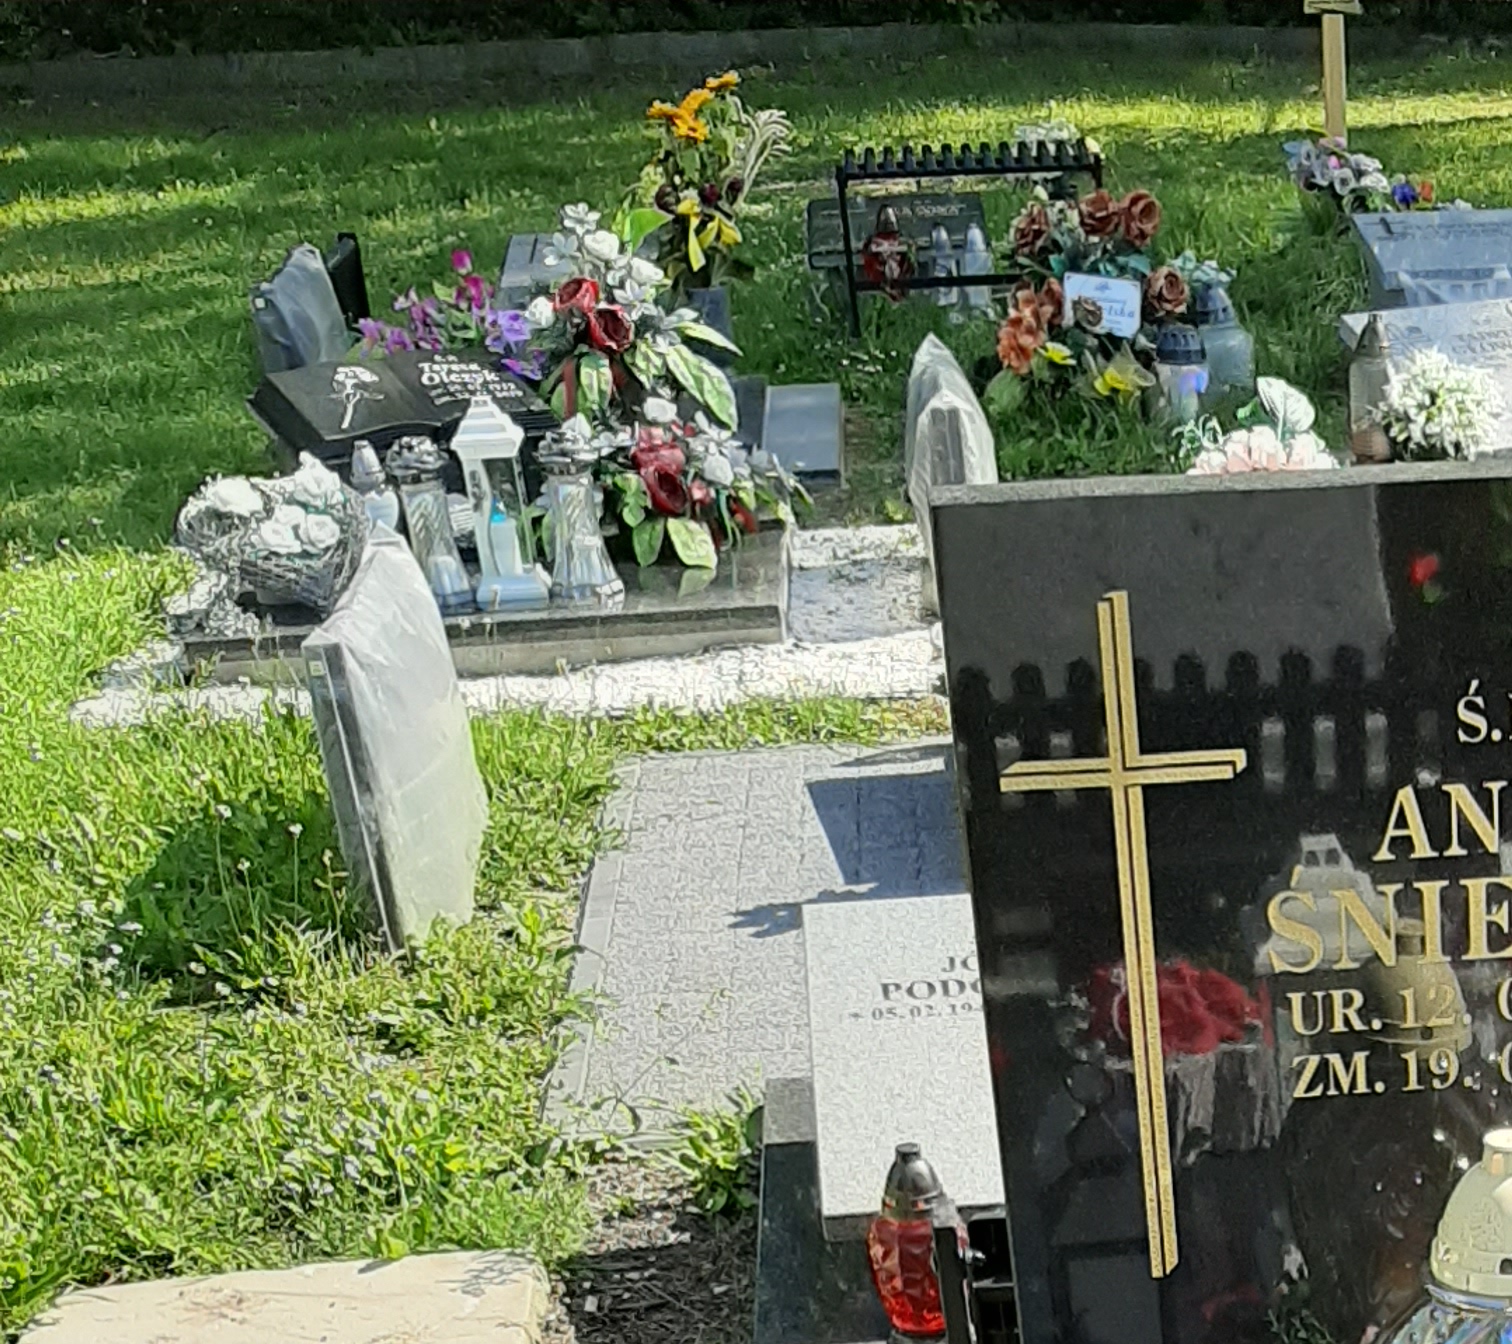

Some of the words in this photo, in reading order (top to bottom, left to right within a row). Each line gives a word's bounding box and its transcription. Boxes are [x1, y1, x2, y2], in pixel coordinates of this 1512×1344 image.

[1286, 988, 1383, 1037] UR.
[1399, 984, 1473, 1030] 12.
[1291, 1050, 1386, 1098] ZM.
[1400, 1048, 1473, 1092] 19.
